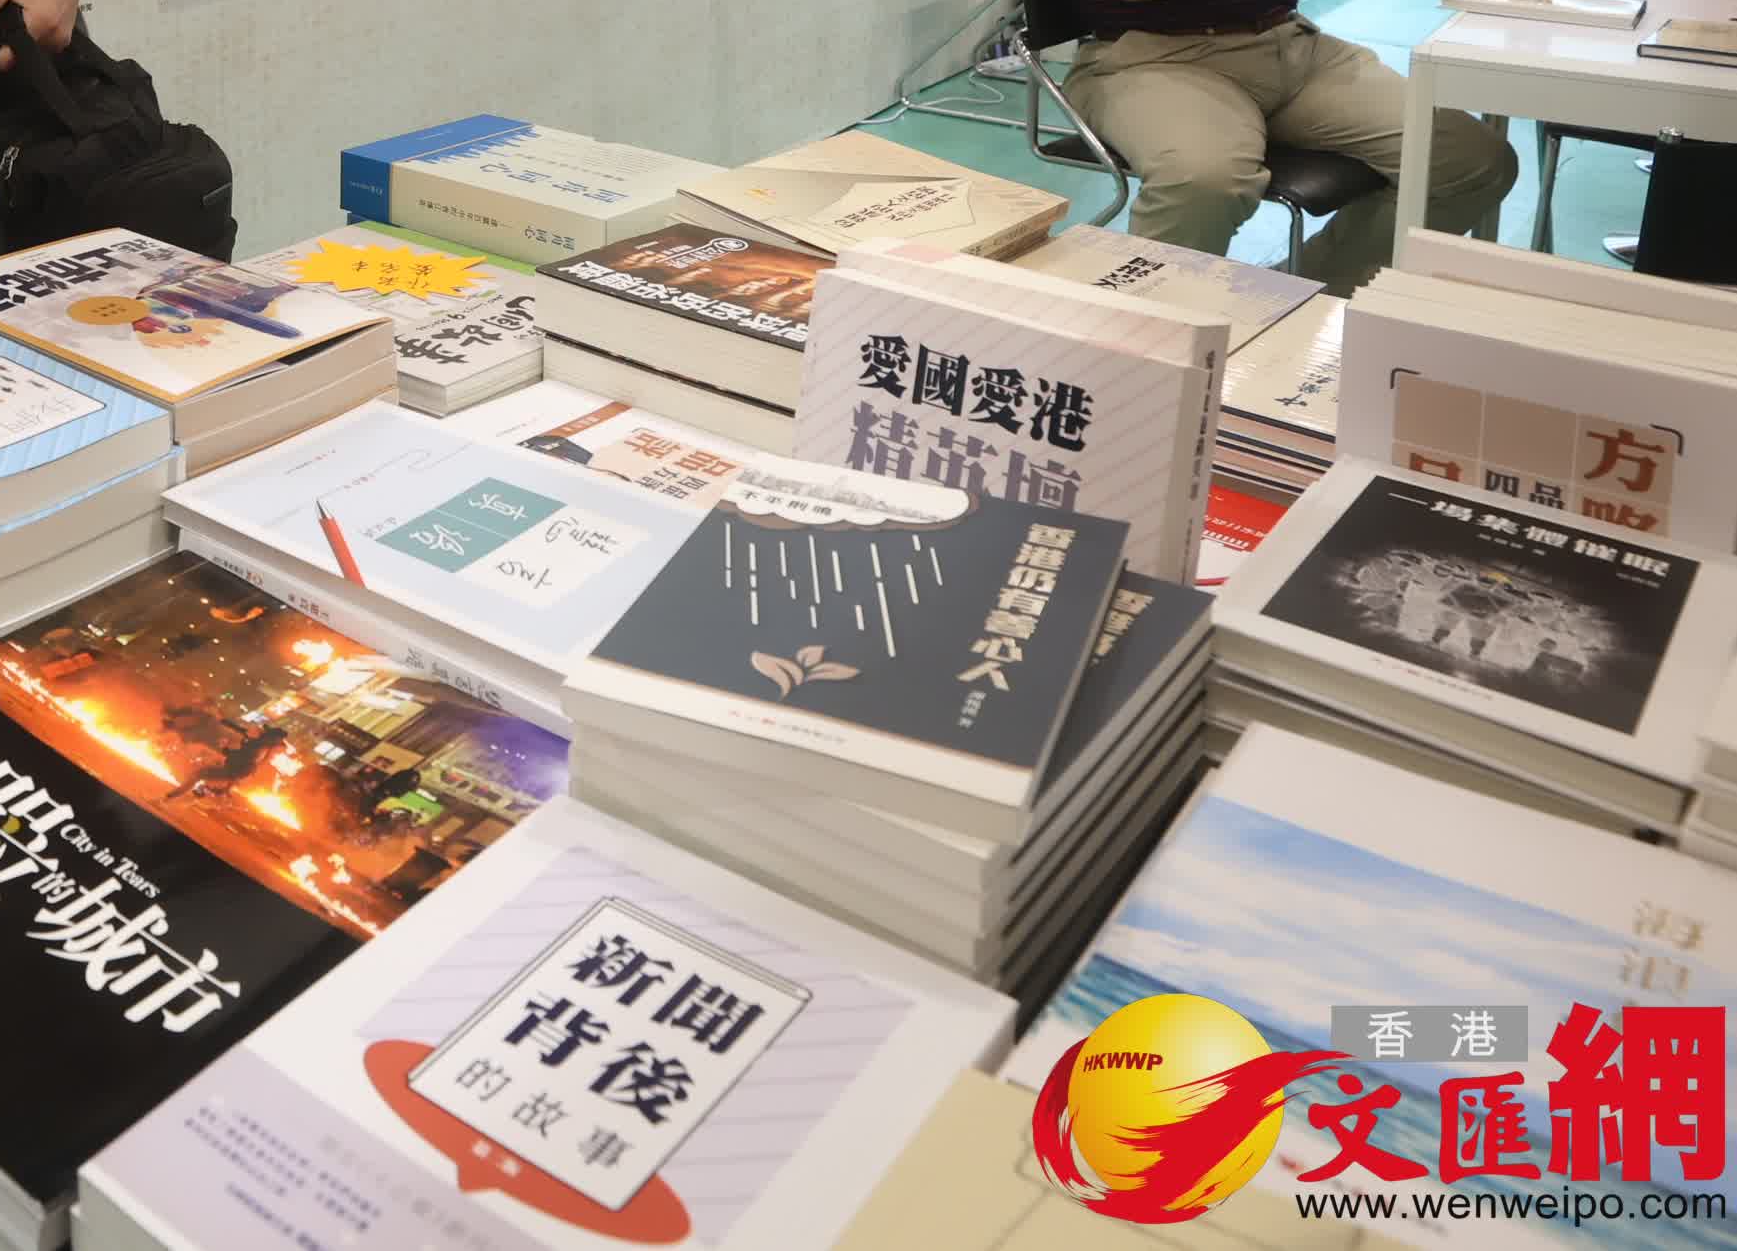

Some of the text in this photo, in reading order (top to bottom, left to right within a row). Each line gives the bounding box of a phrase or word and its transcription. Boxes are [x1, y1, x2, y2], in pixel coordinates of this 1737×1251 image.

[858, 332, 1095, 453] 愛國愛港
[60, 824, 98, 855] City
[112, 857, 161, 900] Tears
[567, 934, 766, 1055] 新聞
[455, 1057, 635, 1173] 的故事
[503, 996, 696, 1125] 背後
